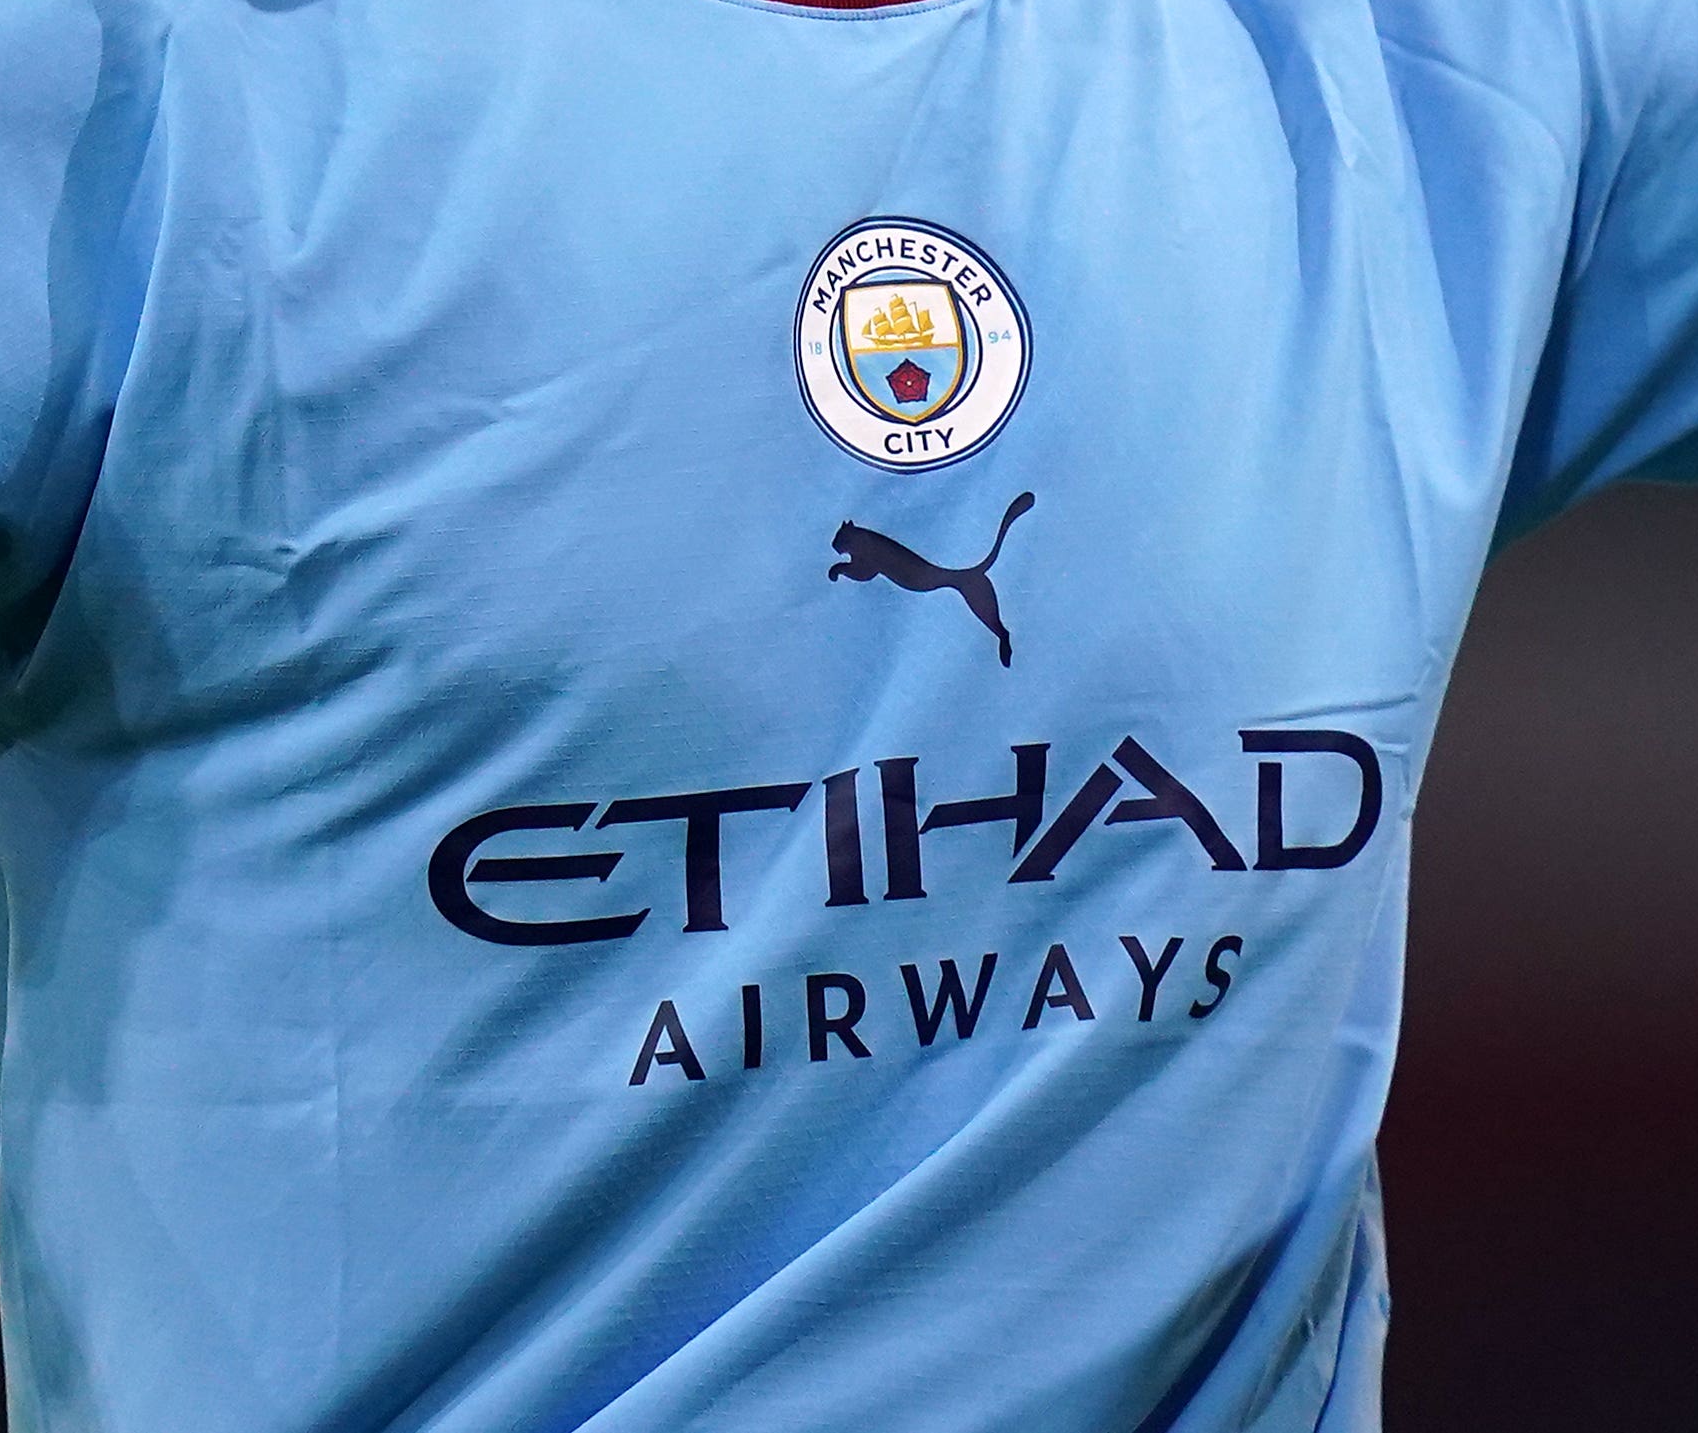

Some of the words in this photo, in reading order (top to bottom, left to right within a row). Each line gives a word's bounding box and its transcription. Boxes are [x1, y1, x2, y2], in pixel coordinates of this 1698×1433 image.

[811, 236, 993, 315] MANCHESTER
[807, 341, 823, 356] 18
[987, 329, 1013, 345] 94
[883, 426, 955, 455] CITY
[427, 728, 1384, 947] ETIHAD
[627, 934, 1244, 1087] AIRWAYS
